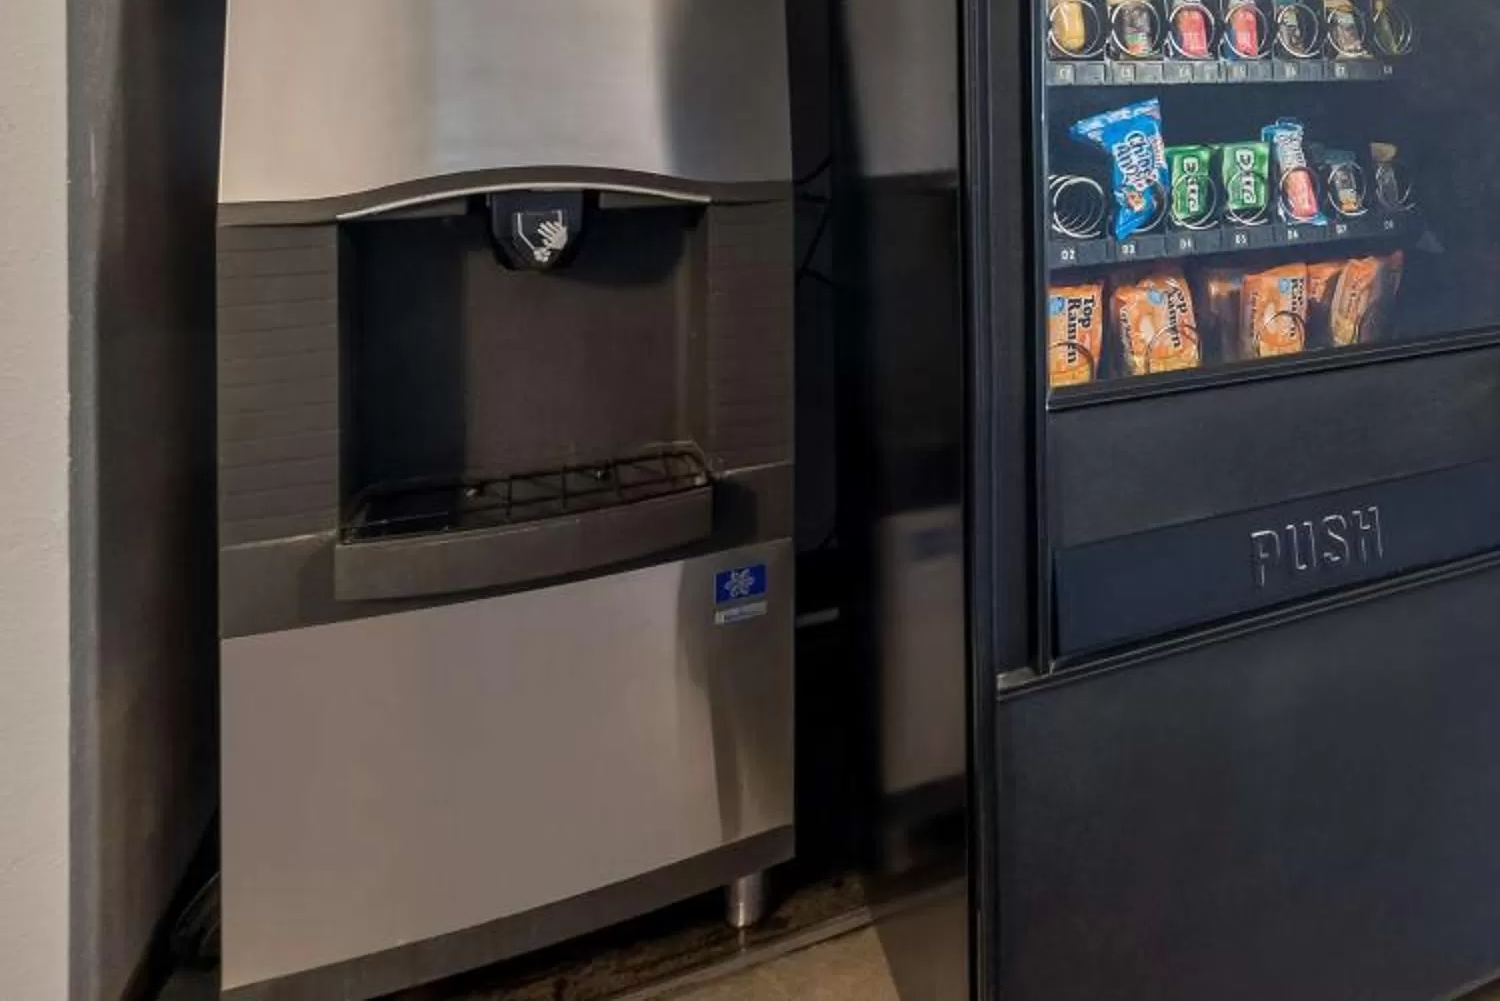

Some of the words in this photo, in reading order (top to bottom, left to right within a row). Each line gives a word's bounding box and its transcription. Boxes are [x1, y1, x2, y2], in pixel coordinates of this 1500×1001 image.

[1066, 297, 1083, 365] Ramen
[1079, 294, 1096, 329] Top
[1250, 505, 1384, 588] PUSH
